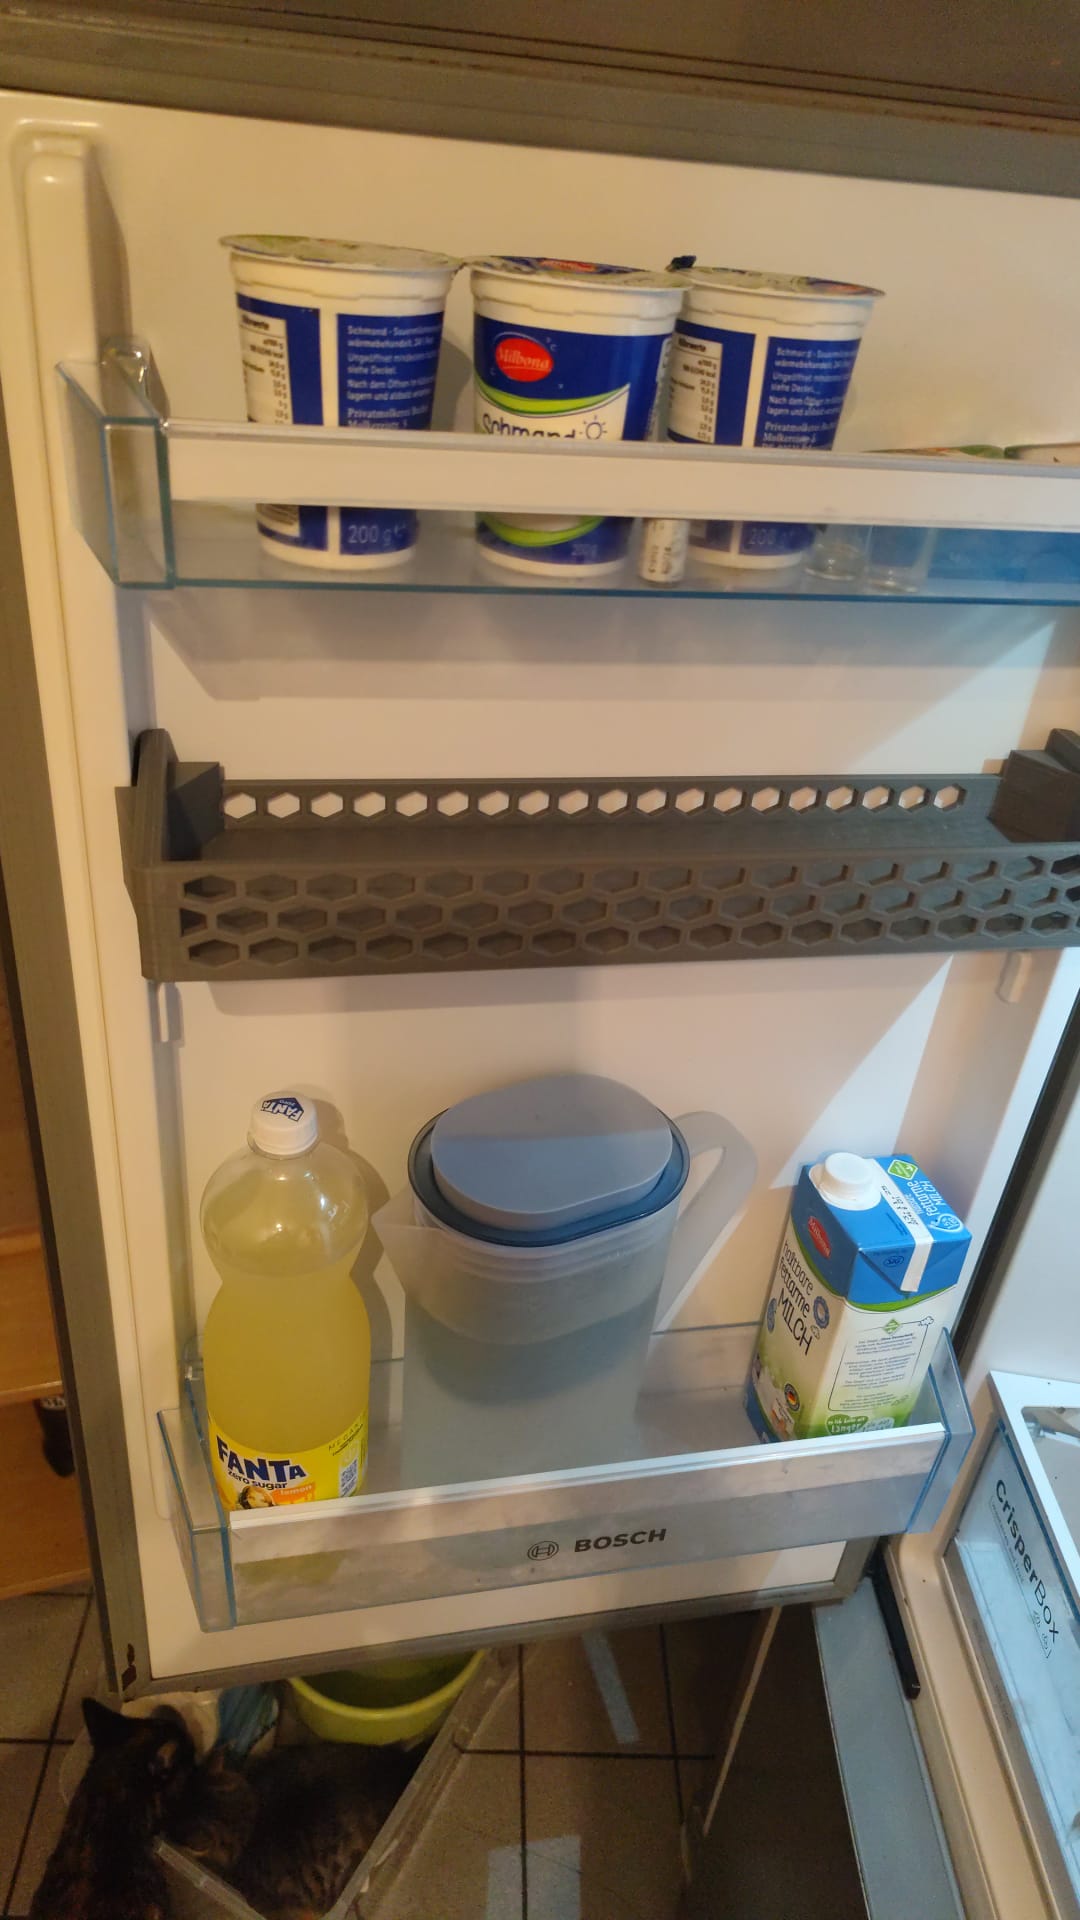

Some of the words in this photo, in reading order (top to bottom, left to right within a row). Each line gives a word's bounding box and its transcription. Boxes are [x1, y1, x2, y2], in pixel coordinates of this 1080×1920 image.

[500, 348, 550, 370] Milbona
[347, 524, 379, 544] 200
[261, 1100, 304, 1121] FANTA
[782, 1240, 814, 1296] haltbare
[780, 1257, 810, 1318] fettarme
[778, 1288, 812, 1356] MILCH
[216, 1434, 307, 1483] FANTA
[228, 1470, 250, 1484] zero
[251, 1480, 288, 1491] sugar
[280, 1484, 313, 1496] lemon
[574, 1528, 667, 1552] BOSCH
[996, 1479, 1059, 1644] CrisperBox
